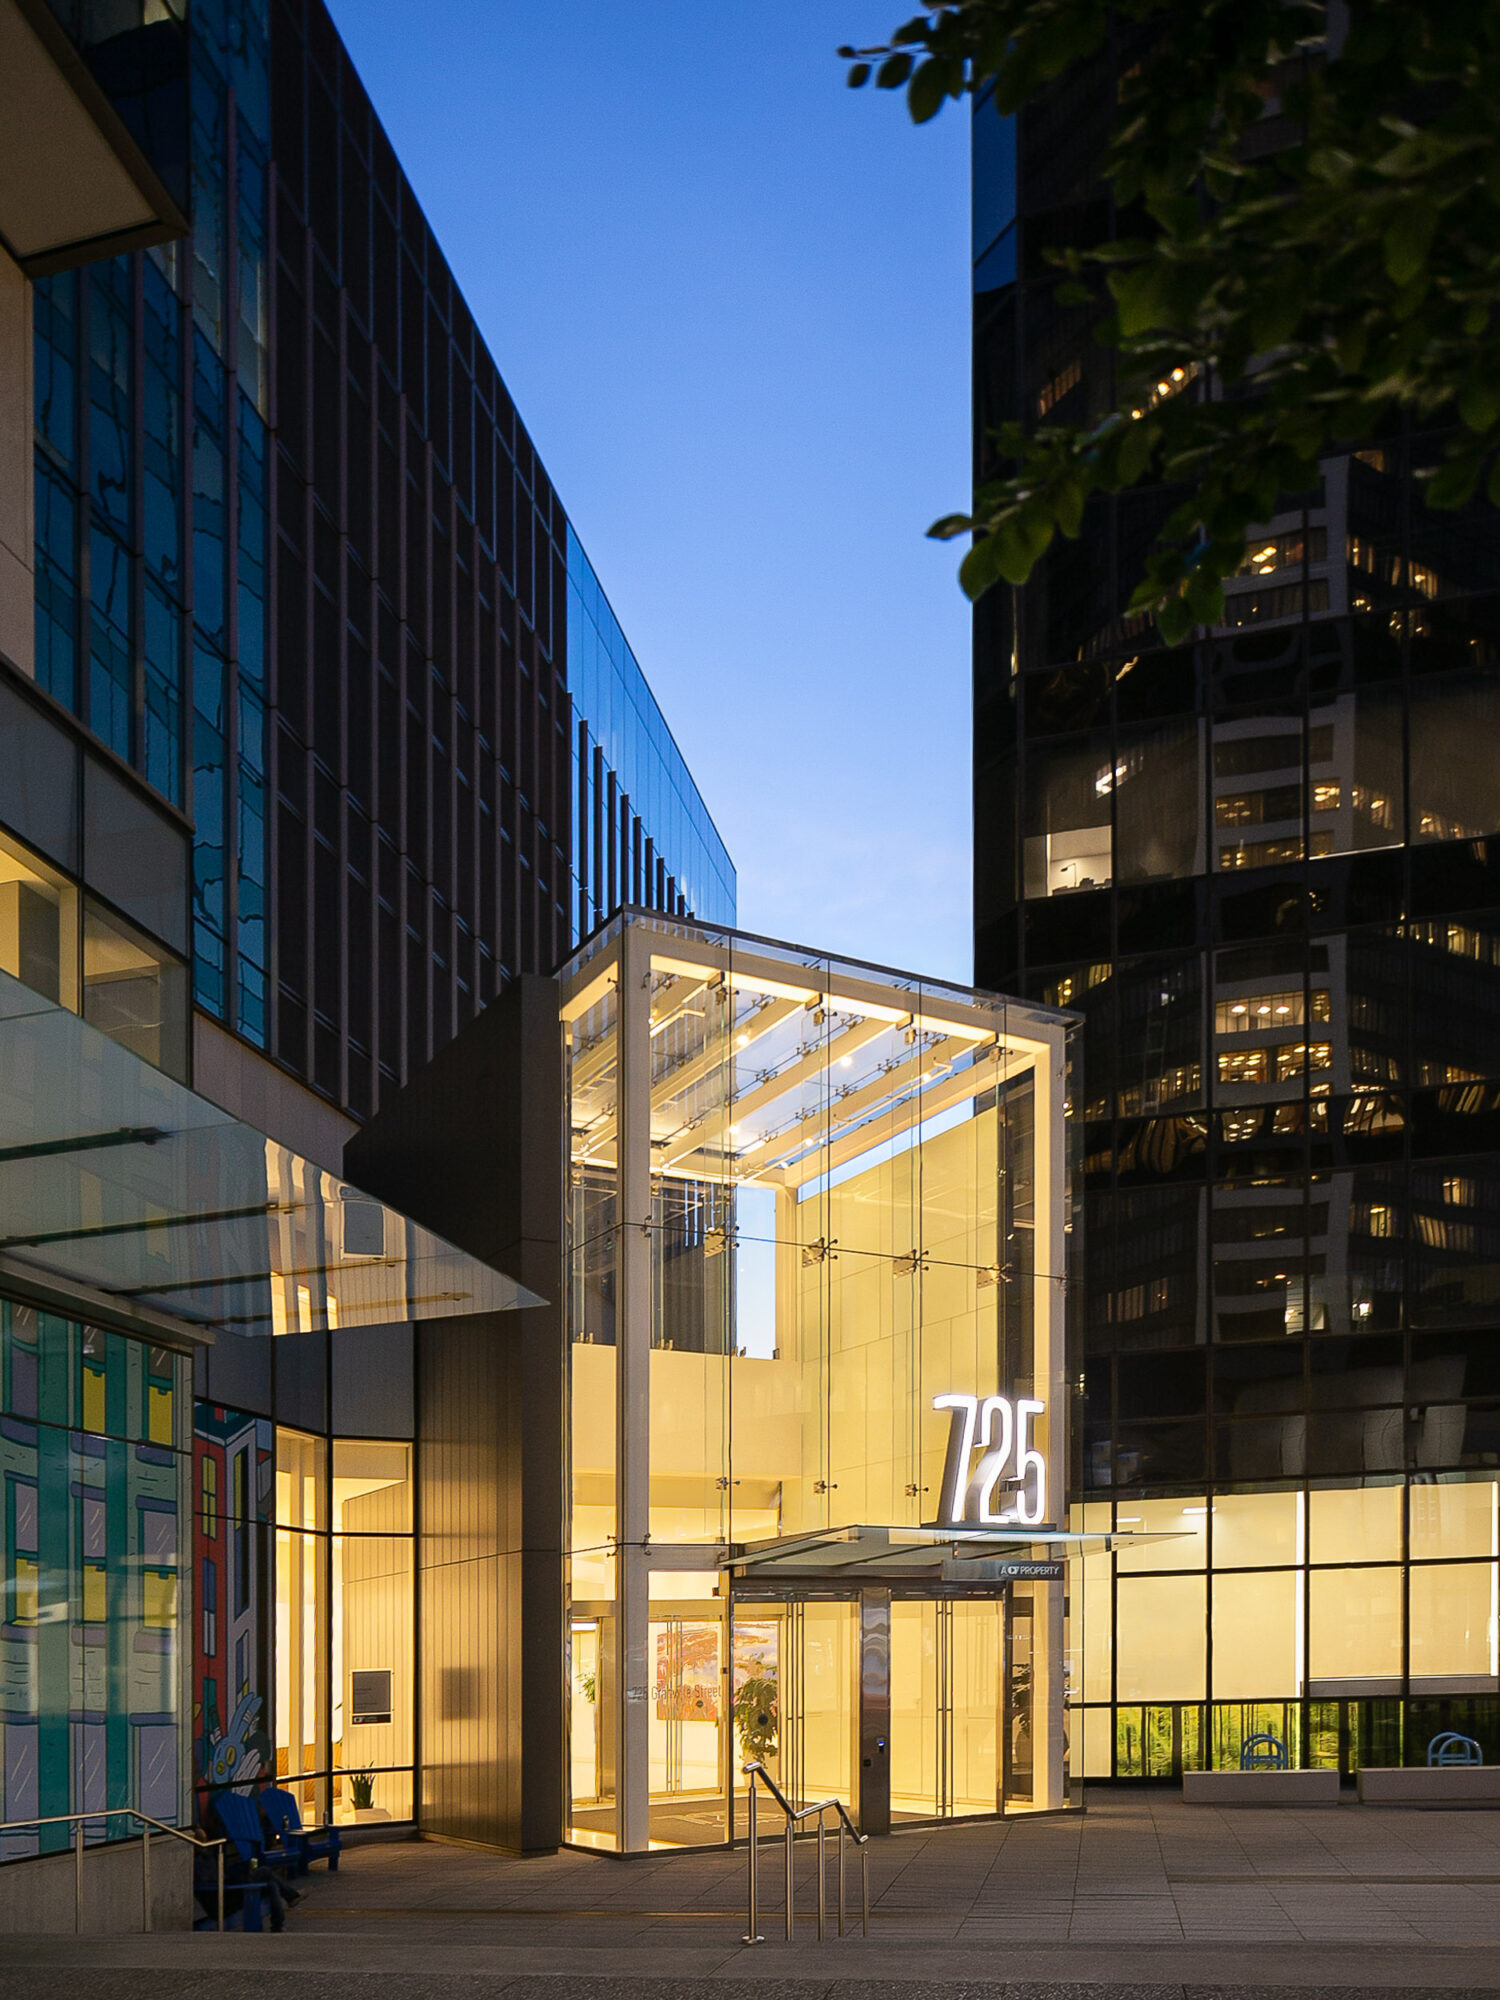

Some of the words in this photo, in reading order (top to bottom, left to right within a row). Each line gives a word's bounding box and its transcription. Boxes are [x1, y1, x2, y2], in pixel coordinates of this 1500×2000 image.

[932, 1393, 1046, 1526] 725
[1000, 1566, 1007, 1575] A
[1020, 1566, 1060, 1575] PROPERTY
[694, 1684, 722, 1698] Street
